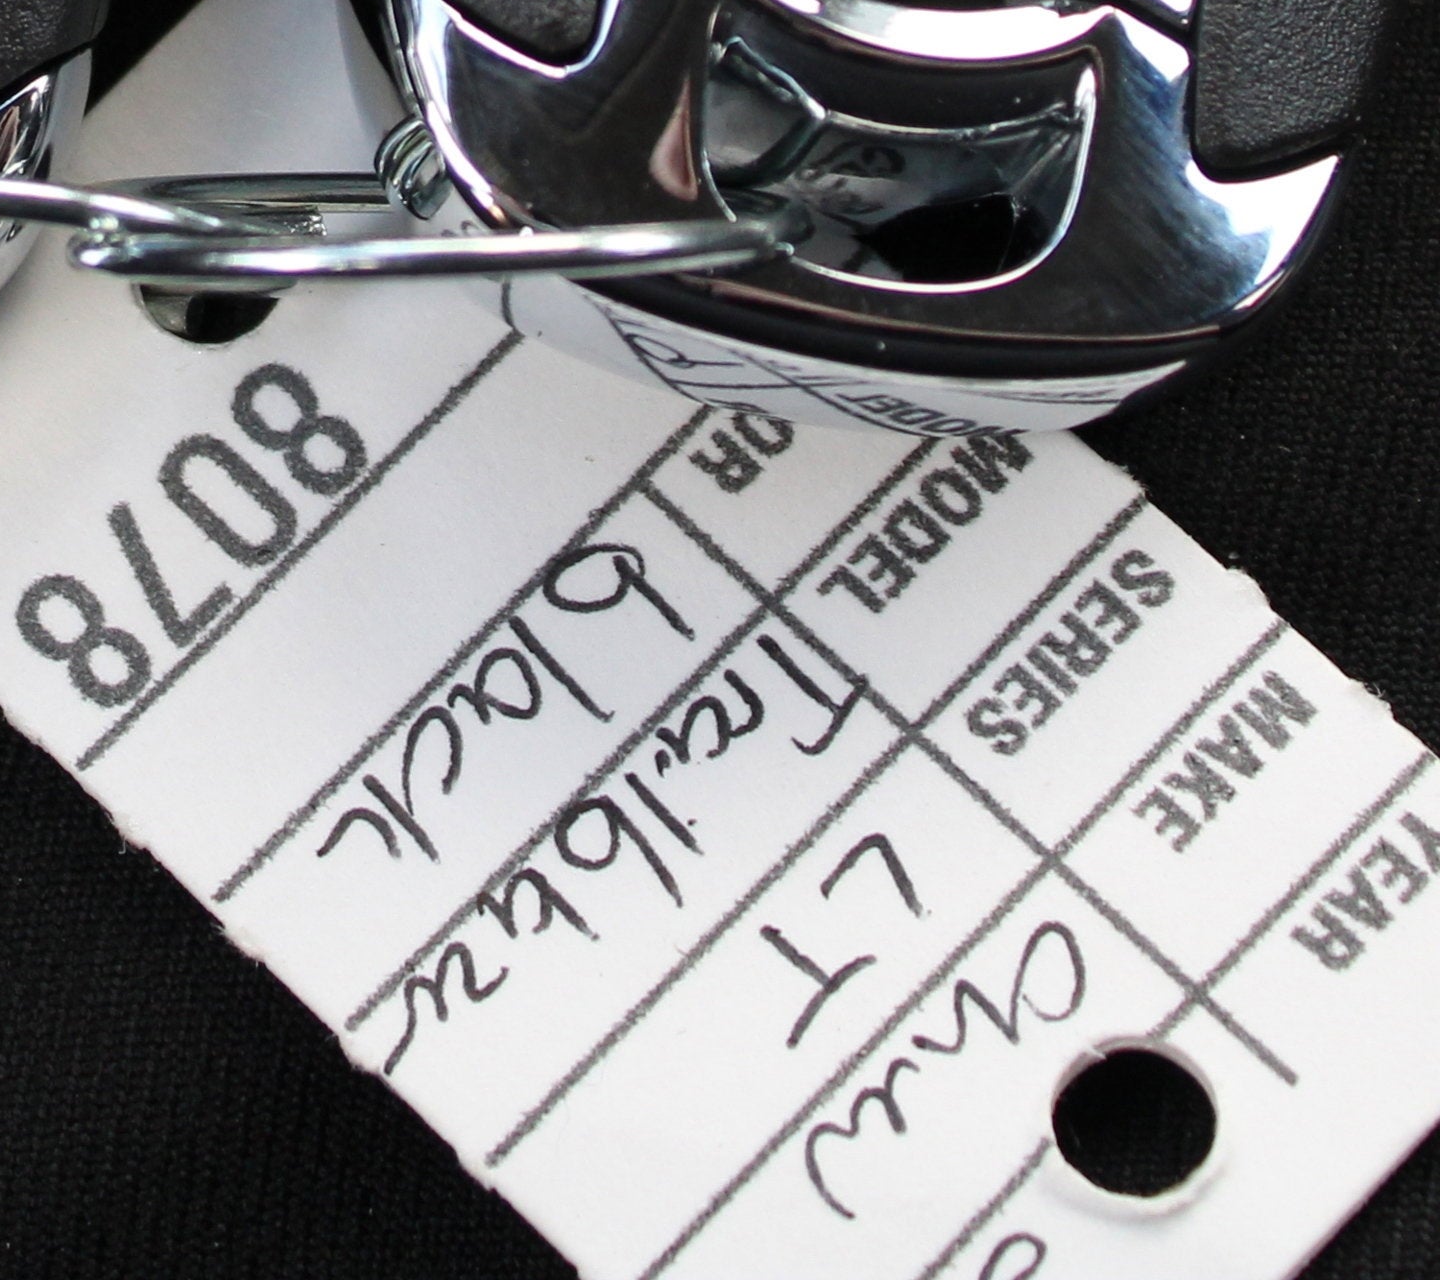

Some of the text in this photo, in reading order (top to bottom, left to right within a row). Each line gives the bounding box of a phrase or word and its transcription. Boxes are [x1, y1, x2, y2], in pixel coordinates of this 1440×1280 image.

[16, 362, 367, 708] 8078
[689, 411, 795, 494] OR
[817, 429, 1034, 613] MODEL
[317, 543, 696, 864] black
[964, 548, 1176, 756] SERIES
[1132, 670, 1318, 854] MAKE
